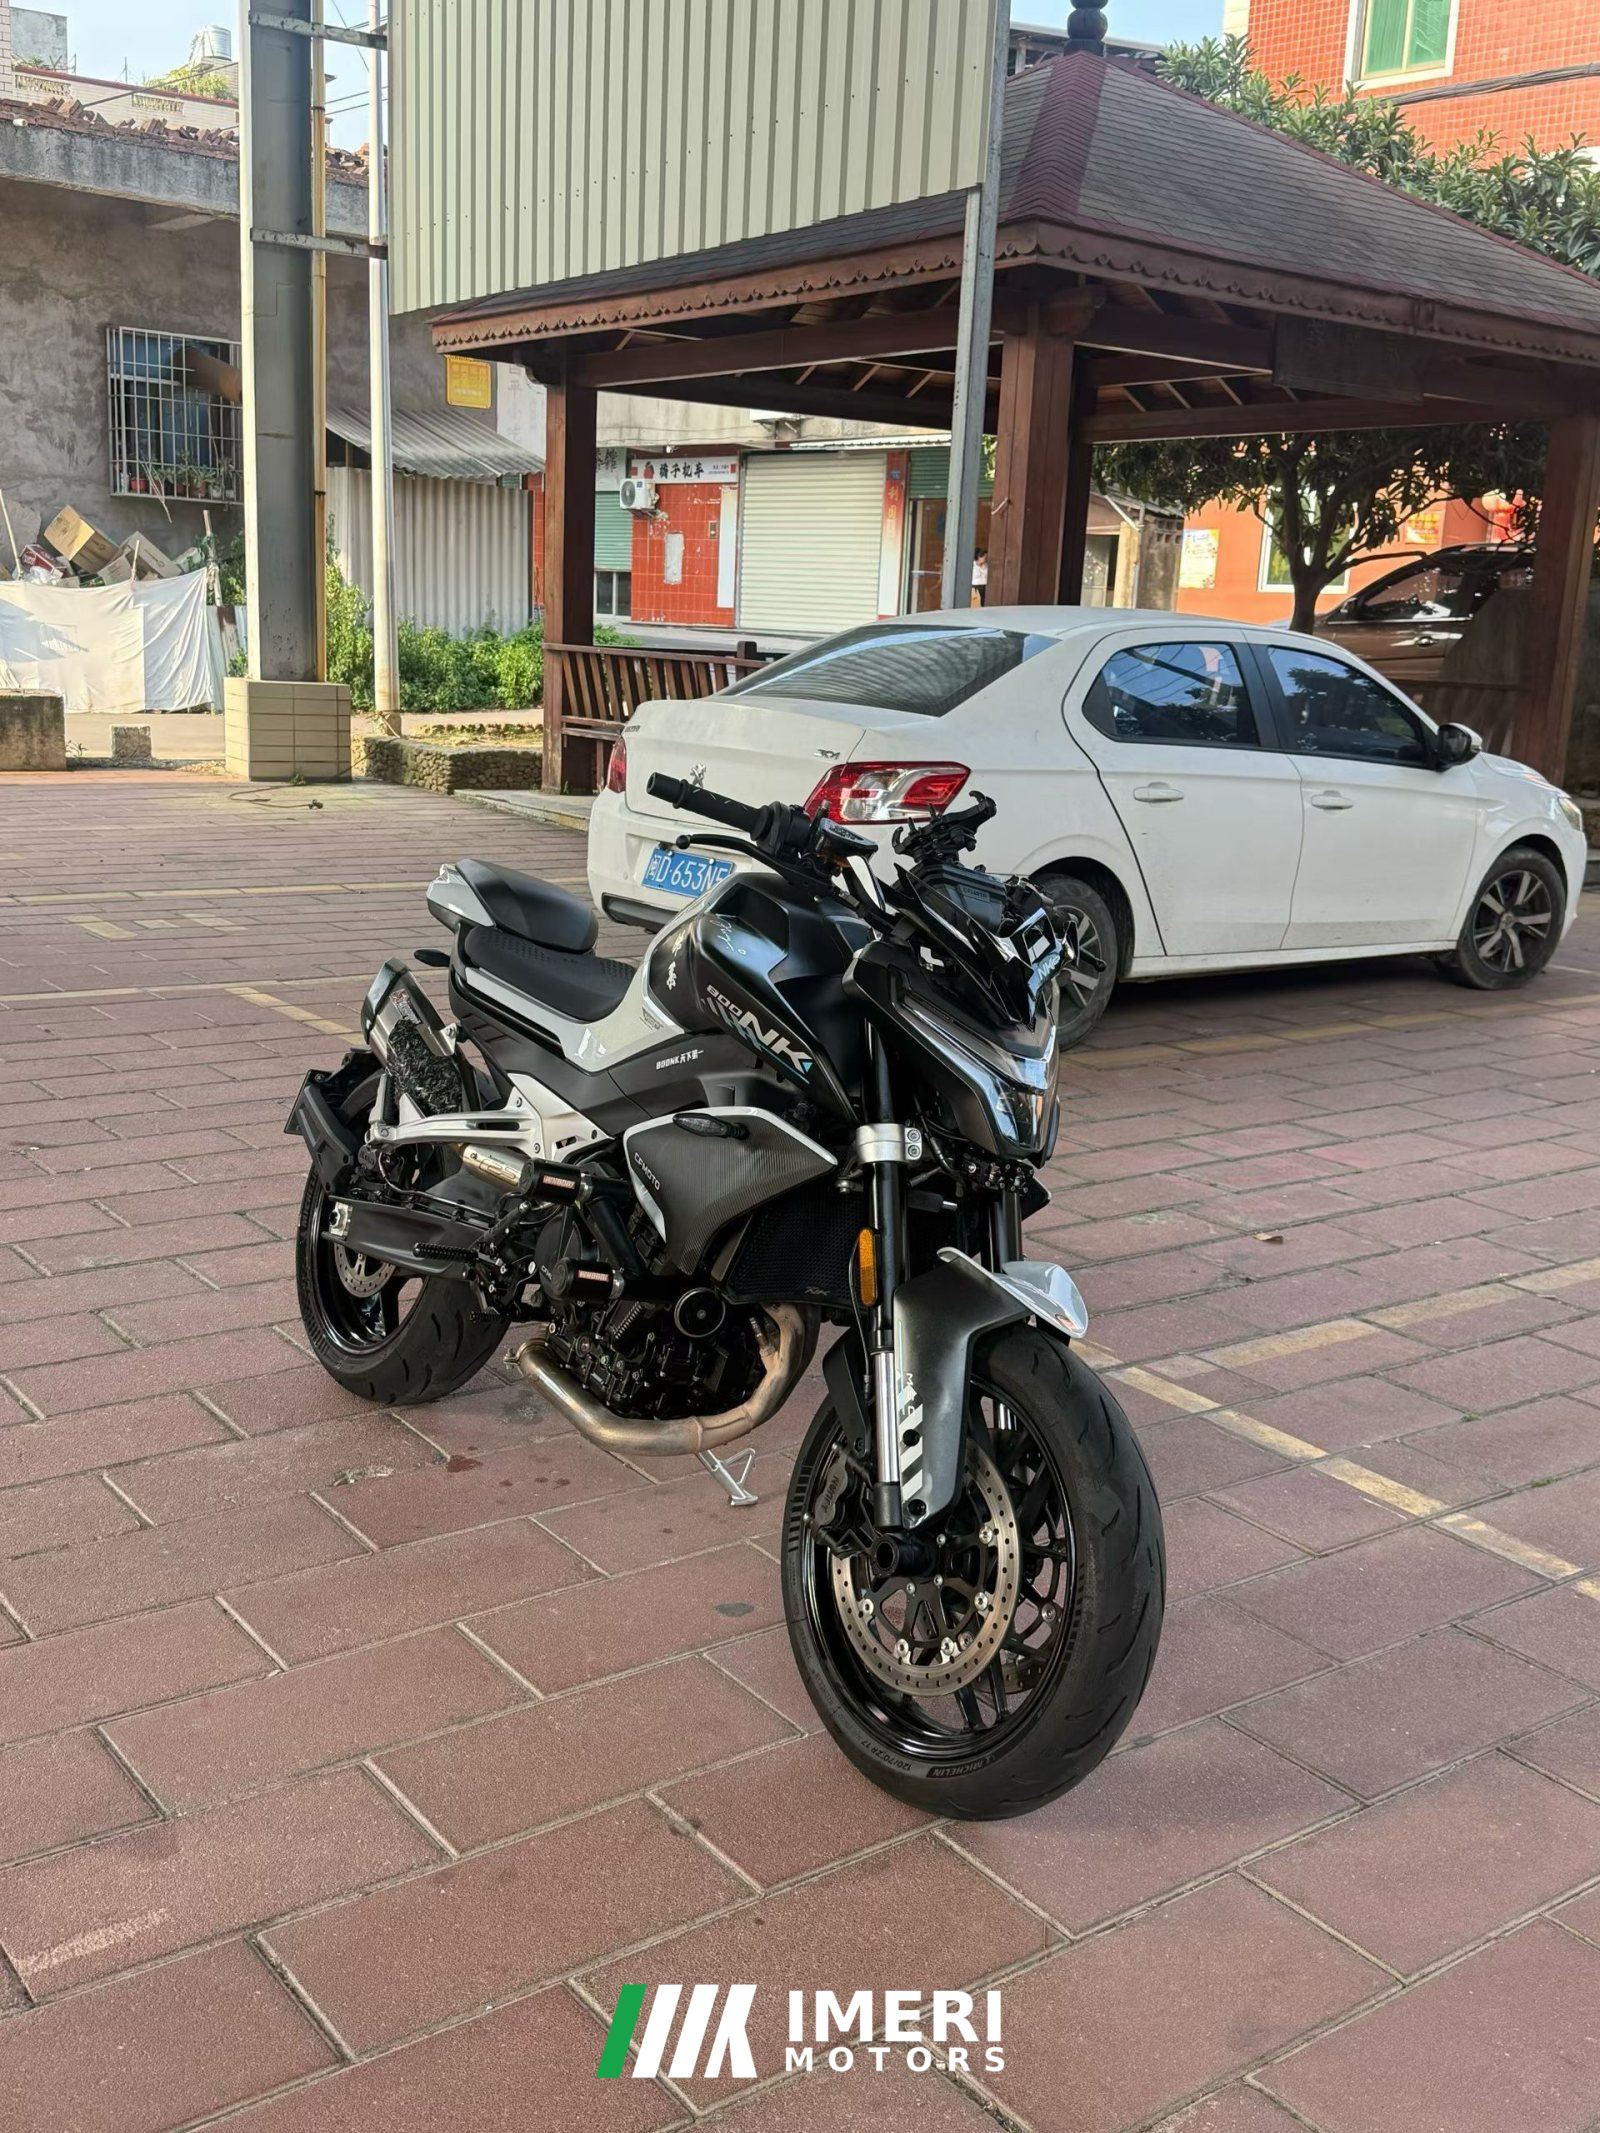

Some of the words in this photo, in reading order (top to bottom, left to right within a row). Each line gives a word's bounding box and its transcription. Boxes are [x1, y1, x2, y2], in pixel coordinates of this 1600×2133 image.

[706, 984, 743, 1018] 800
[738, 1011, 813, 1075] NK
[634, 1151, 661, 1191] CFMOTO
[932, 1761, 984, 1777] MICHELIN
